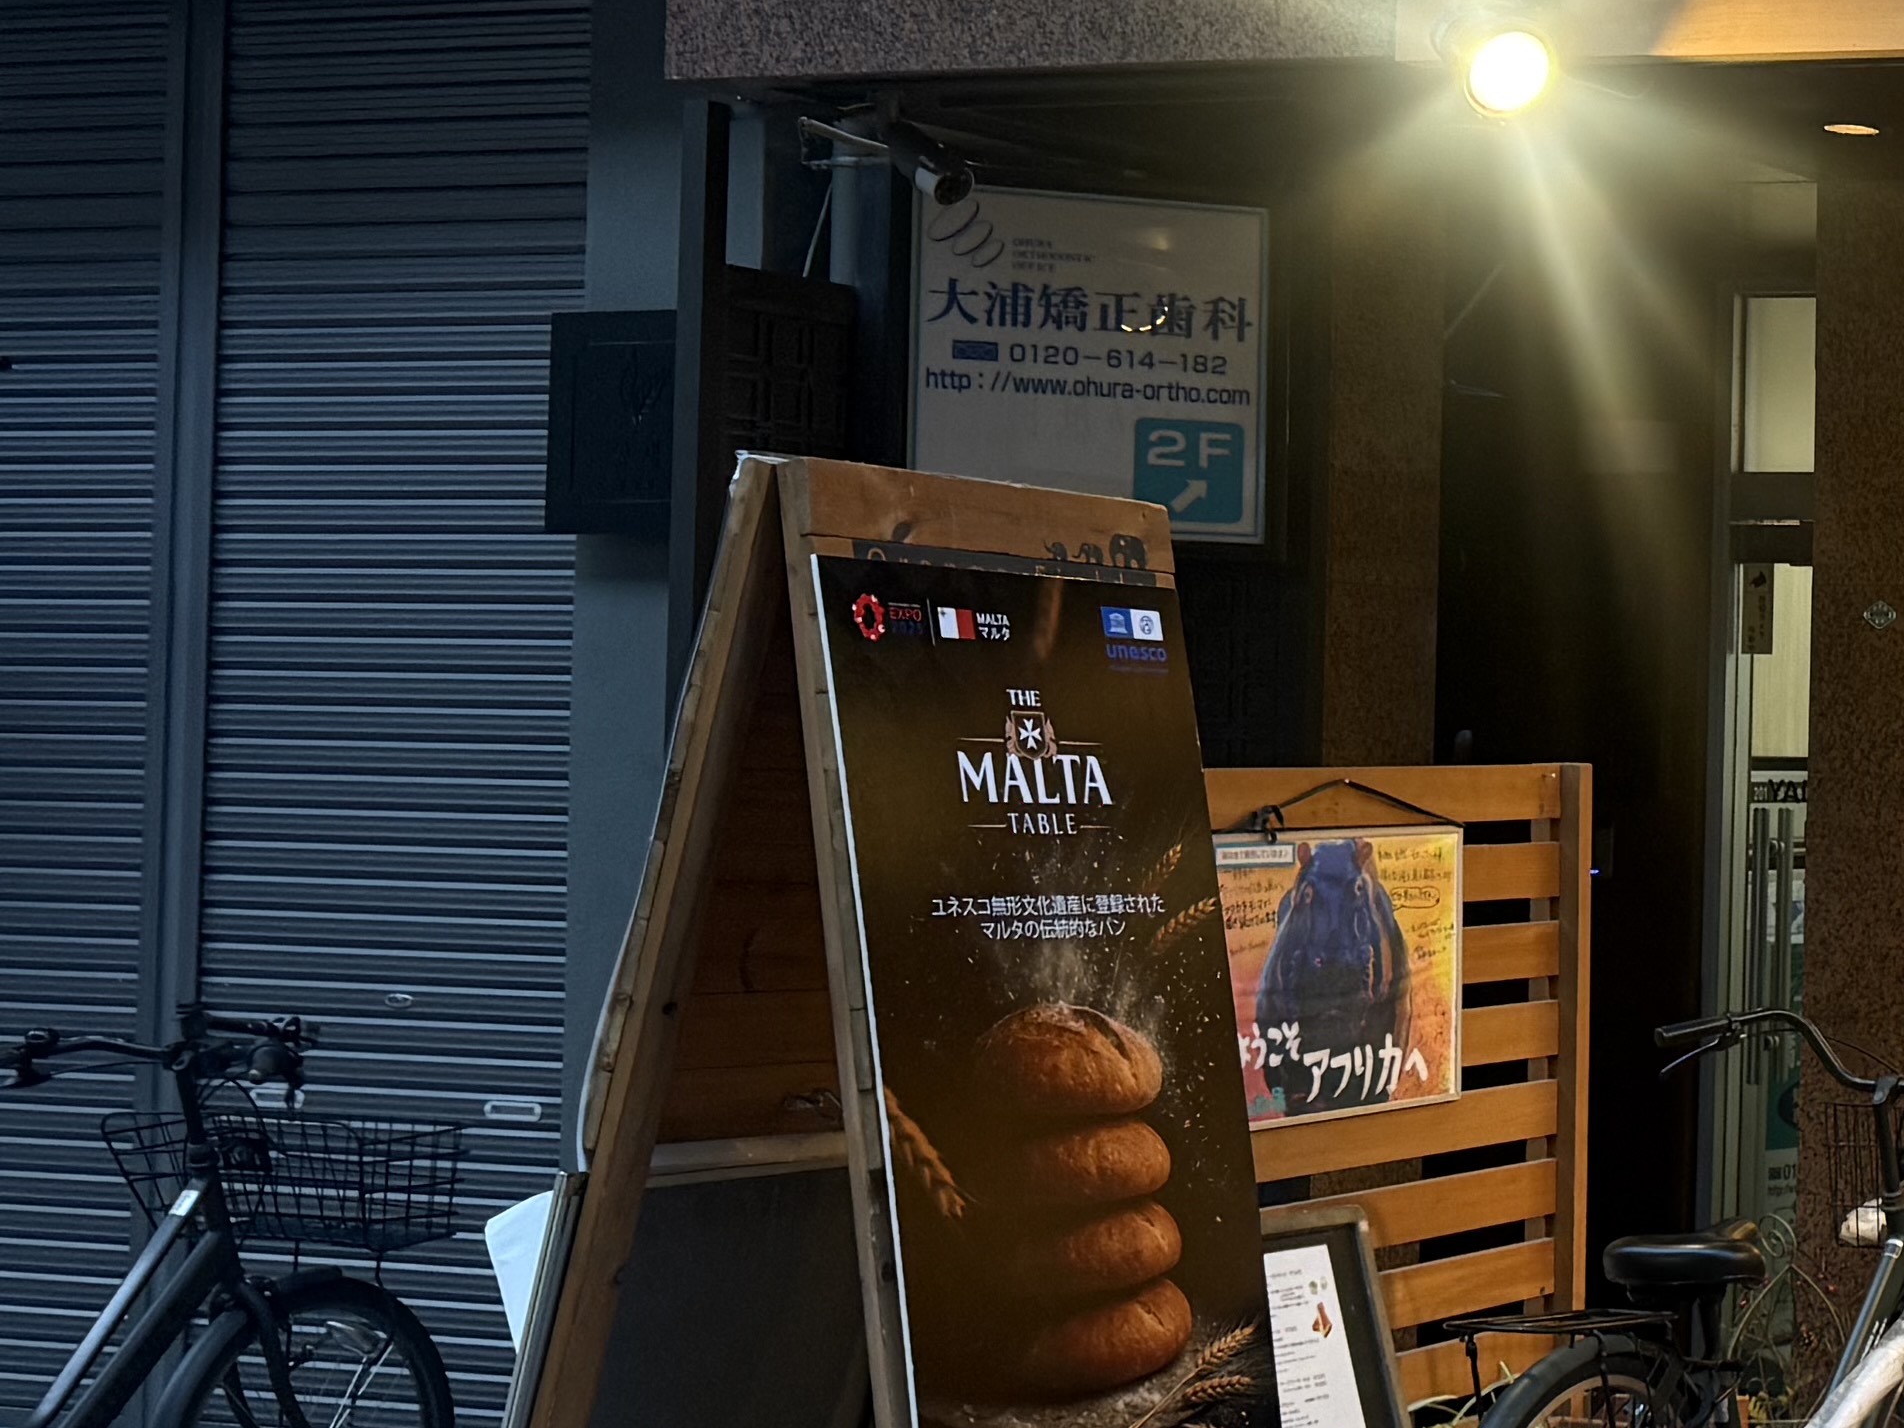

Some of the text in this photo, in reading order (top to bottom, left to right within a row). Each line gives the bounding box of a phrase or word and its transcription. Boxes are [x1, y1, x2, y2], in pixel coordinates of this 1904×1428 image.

[927, 277, 1253, 343] 大浦矯正歯科
[1009, 343, 1228, 376] 0120-614-182
[1146, 429, 1233, 469] 2F
[975, 613, 1011, 626] MALTA
[977, 626, 1011, 642] マルタ
[1106, 643, 1168, 663] unesco
[1006, 688, 1042, 708] THE
[956, 750, 1114, 805] MALTA
[1007, 812, 1078, 835] TABLE
[931, 893, 1166, 918] ユネスコ無形文化遺産に登録された
[980, 918, 1127, 940] マルタの伝統的なパン
[1303, 1033, 1429, 1104] アフリカへ
